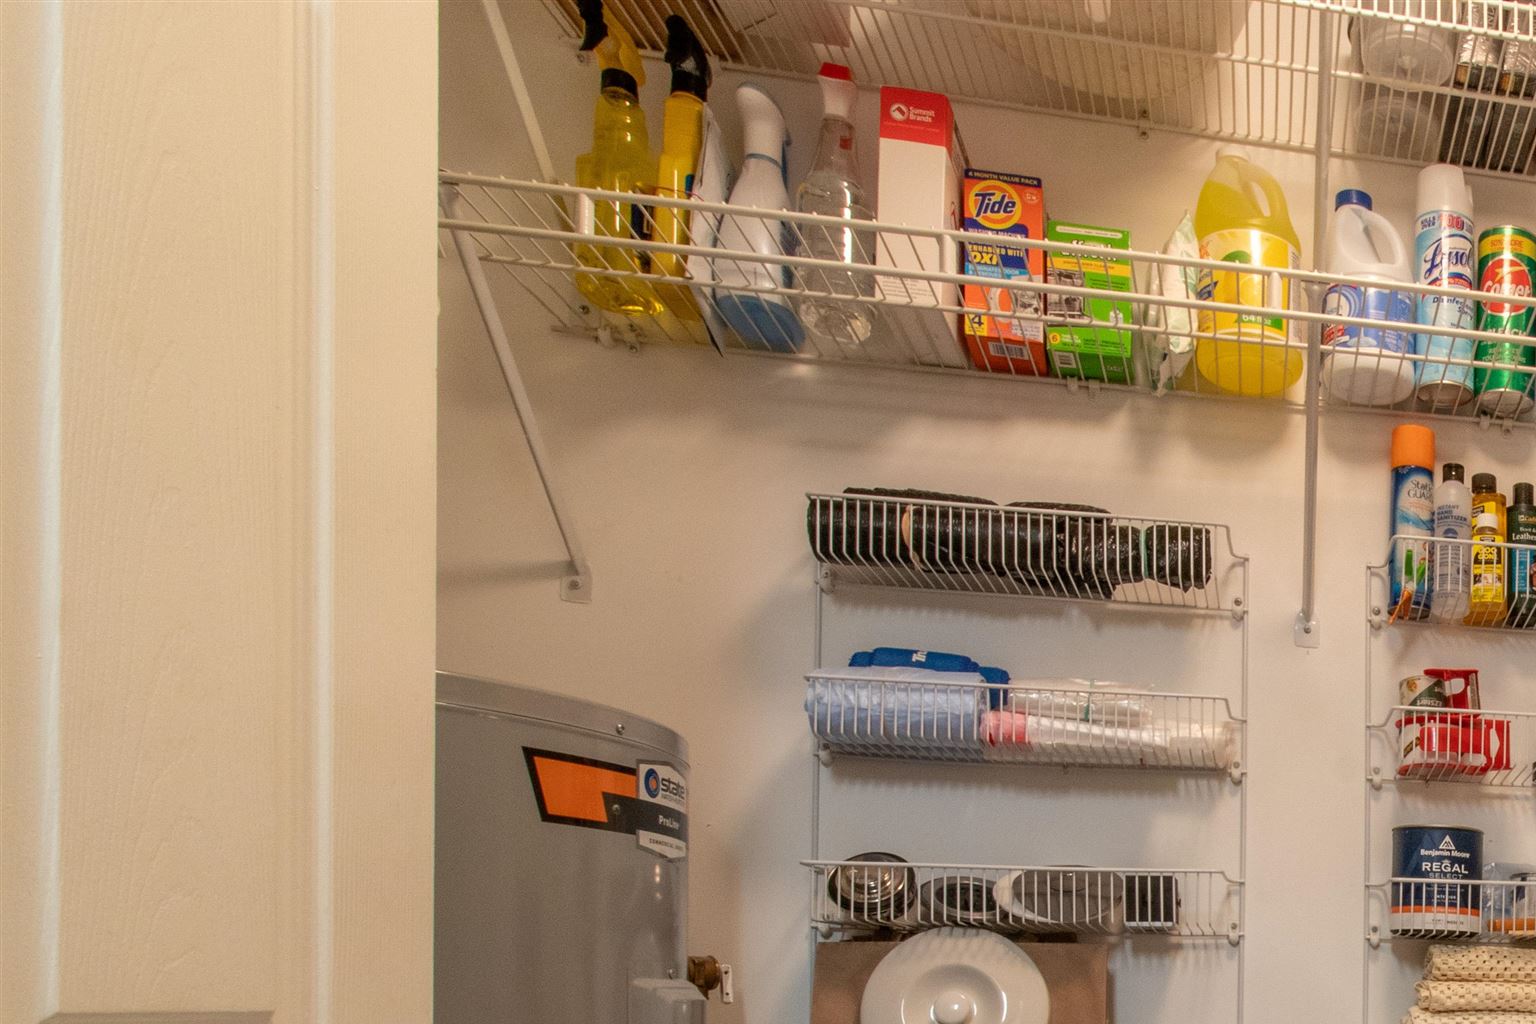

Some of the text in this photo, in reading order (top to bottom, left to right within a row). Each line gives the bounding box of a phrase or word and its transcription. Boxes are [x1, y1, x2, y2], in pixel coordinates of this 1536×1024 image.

[909, 106, 935, 118] Summit
[909, 113, 932, 123] Brands
[999, 174, 1020, 182] VALUE
[1021, 178, 1038, 186] PACK
[974, 191, 1017, 219] Tide
[1436, 514, 1467, 523] SANITIZER
[1512, 533, 1536, 542] Leather
[660, 777, 685, 799] state
[1420, 848, 1470, 859] Benjamin Moore
[1421, 861, 1469, 875] REGAL
[1429, 871, 1463, 880] SELECT
